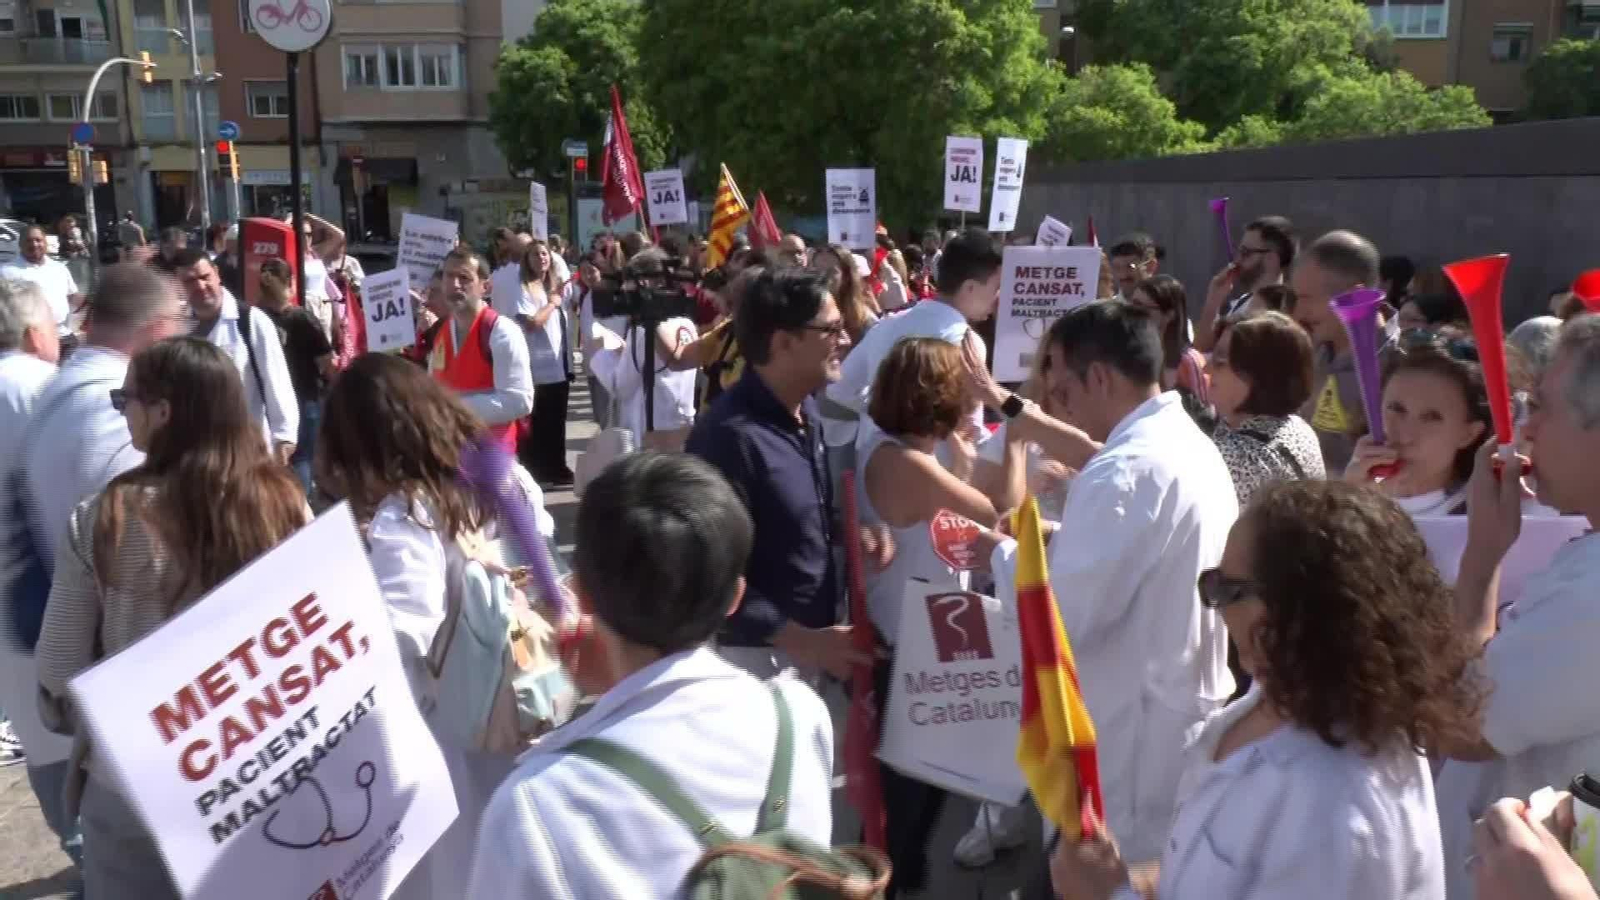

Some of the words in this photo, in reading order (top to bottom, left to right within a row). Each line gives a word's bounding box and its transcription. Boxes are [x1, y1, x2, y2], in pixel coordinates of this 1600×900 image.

[950, 165, 977, 184] JA!
[653, 189, 680, 205] JA!
[253, 242, 279, 254] 279
[1015, 266, 1078, 279] METGE
[1013, 282, 1085, 297] CANSAT,
[371, 297, 406, 322] JA!
[1011, 298, 1057, 307] PACIENT
[1011, 309, 1069, 318] MALTRACT
[149, 591, 329, 746] METGE
[904, 667, 1001, 696] Metges
[1005, 663, 1021, 687] d
[178, 619, 371, 783] CANSAT,
[908, 697, 1018, 726] Catalun
[194, 705, 320, 817] PACIENT
[209, 685, 377, 844] MALTRACTAT
